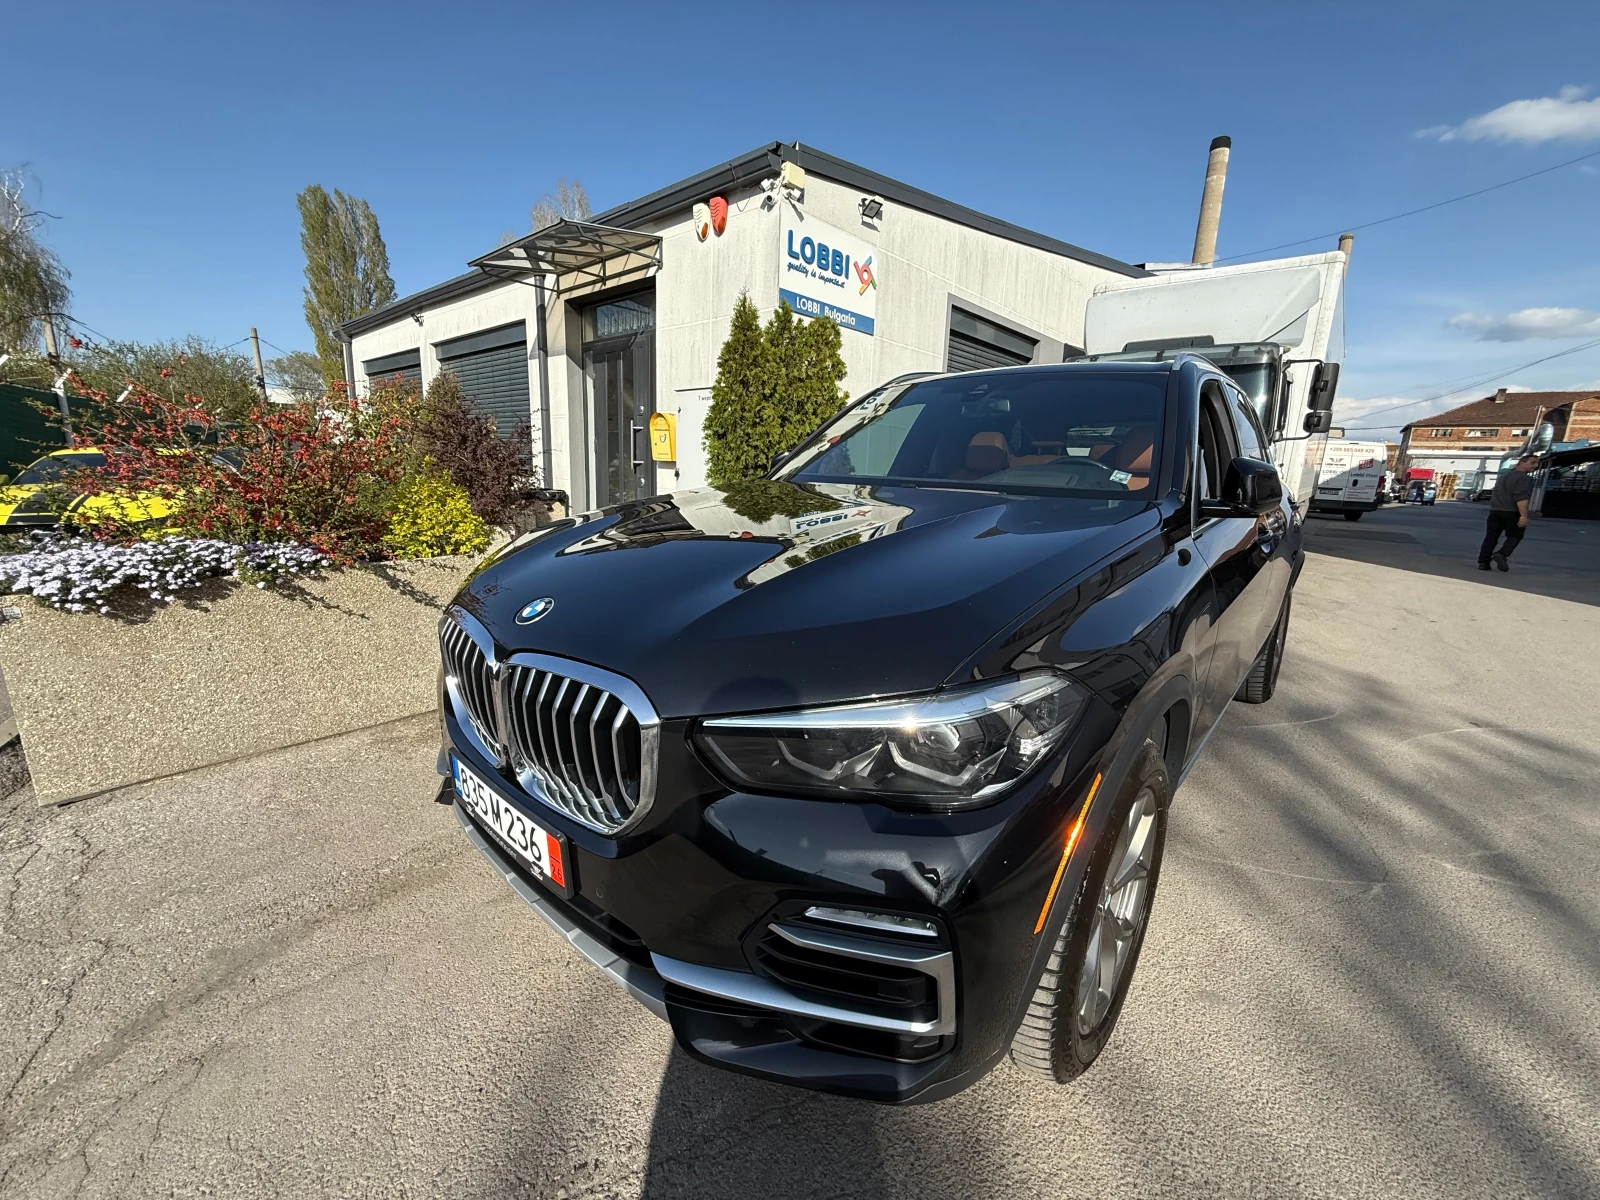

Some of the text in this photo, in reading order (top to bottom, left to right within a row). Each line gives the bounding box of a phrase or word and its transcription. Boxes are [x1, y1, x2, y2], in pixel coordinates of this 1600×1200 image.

[787, 229, 850, 280] LOBBI
[787, 262, 809, 278] quality
[810, 269, 817, 278] is
[796, 296, 856, 326] LOBBI Bulgaria
[504, 809, 542, 863] 236
